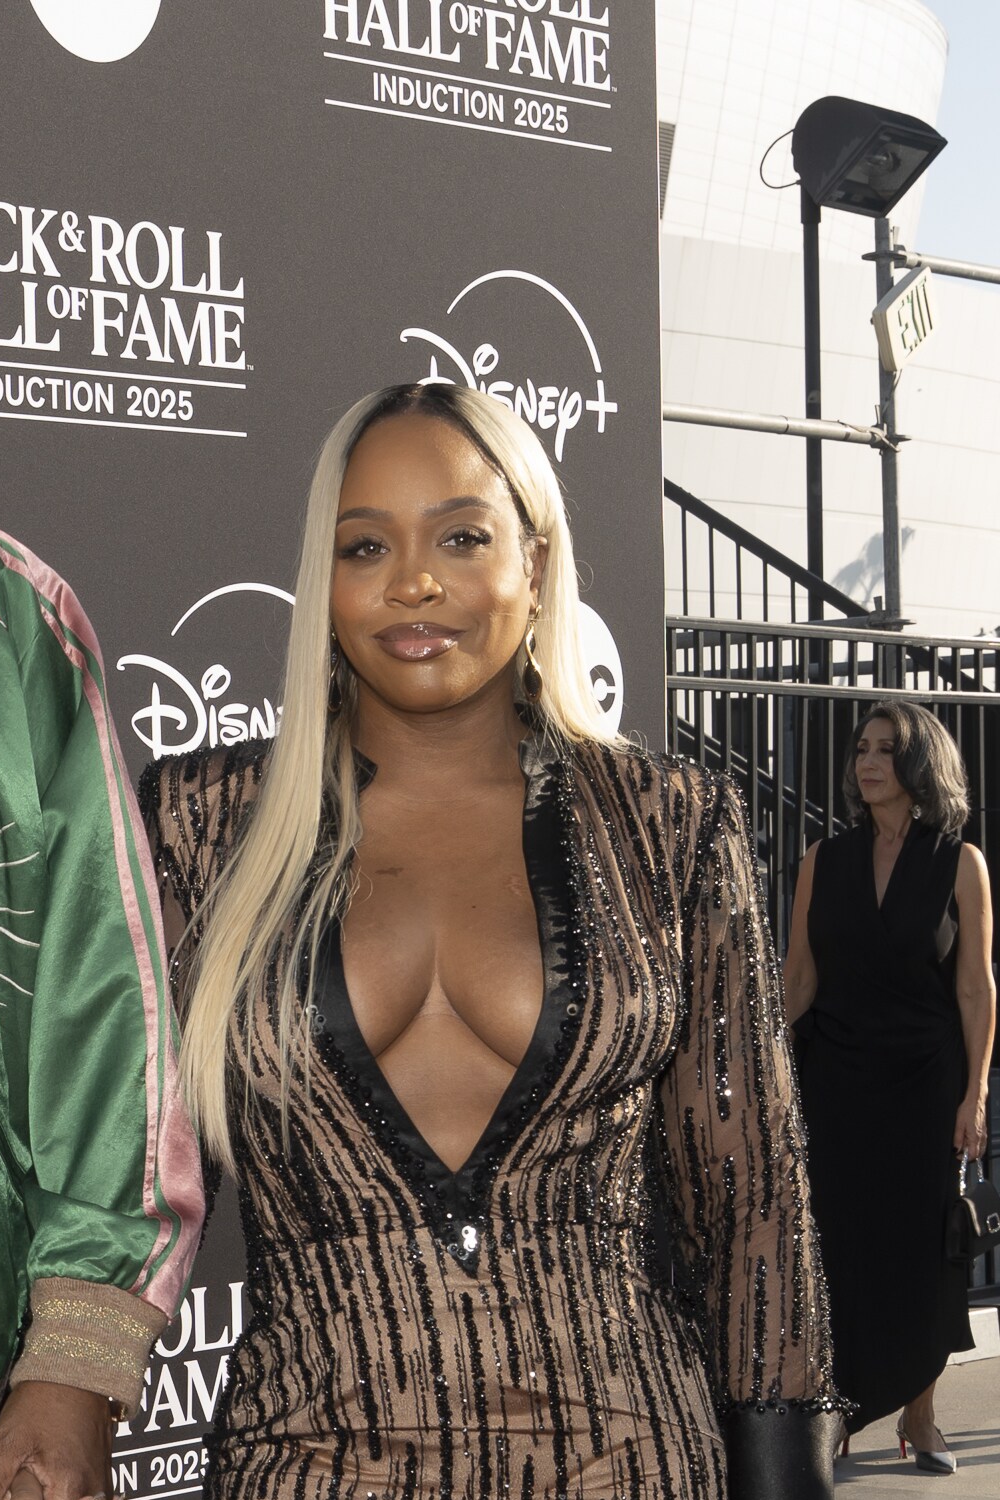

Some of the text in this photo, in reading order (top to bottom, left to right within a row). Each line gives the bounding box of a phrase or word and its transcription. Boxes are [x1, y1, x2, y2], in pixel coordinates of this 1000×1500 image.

[323, 0, 461, 63] HALL
[449, 2, 483, 37] OF
[484, 9, 610, 91] FAME
[373, 72, 569, 133] INDUCTION 2025
[46, 284, 88, 320] OF
[89, 288, 246, 370] FAME
[897, 275, 933, 359] EXIT
[126, 385, 194, 421] 2025
